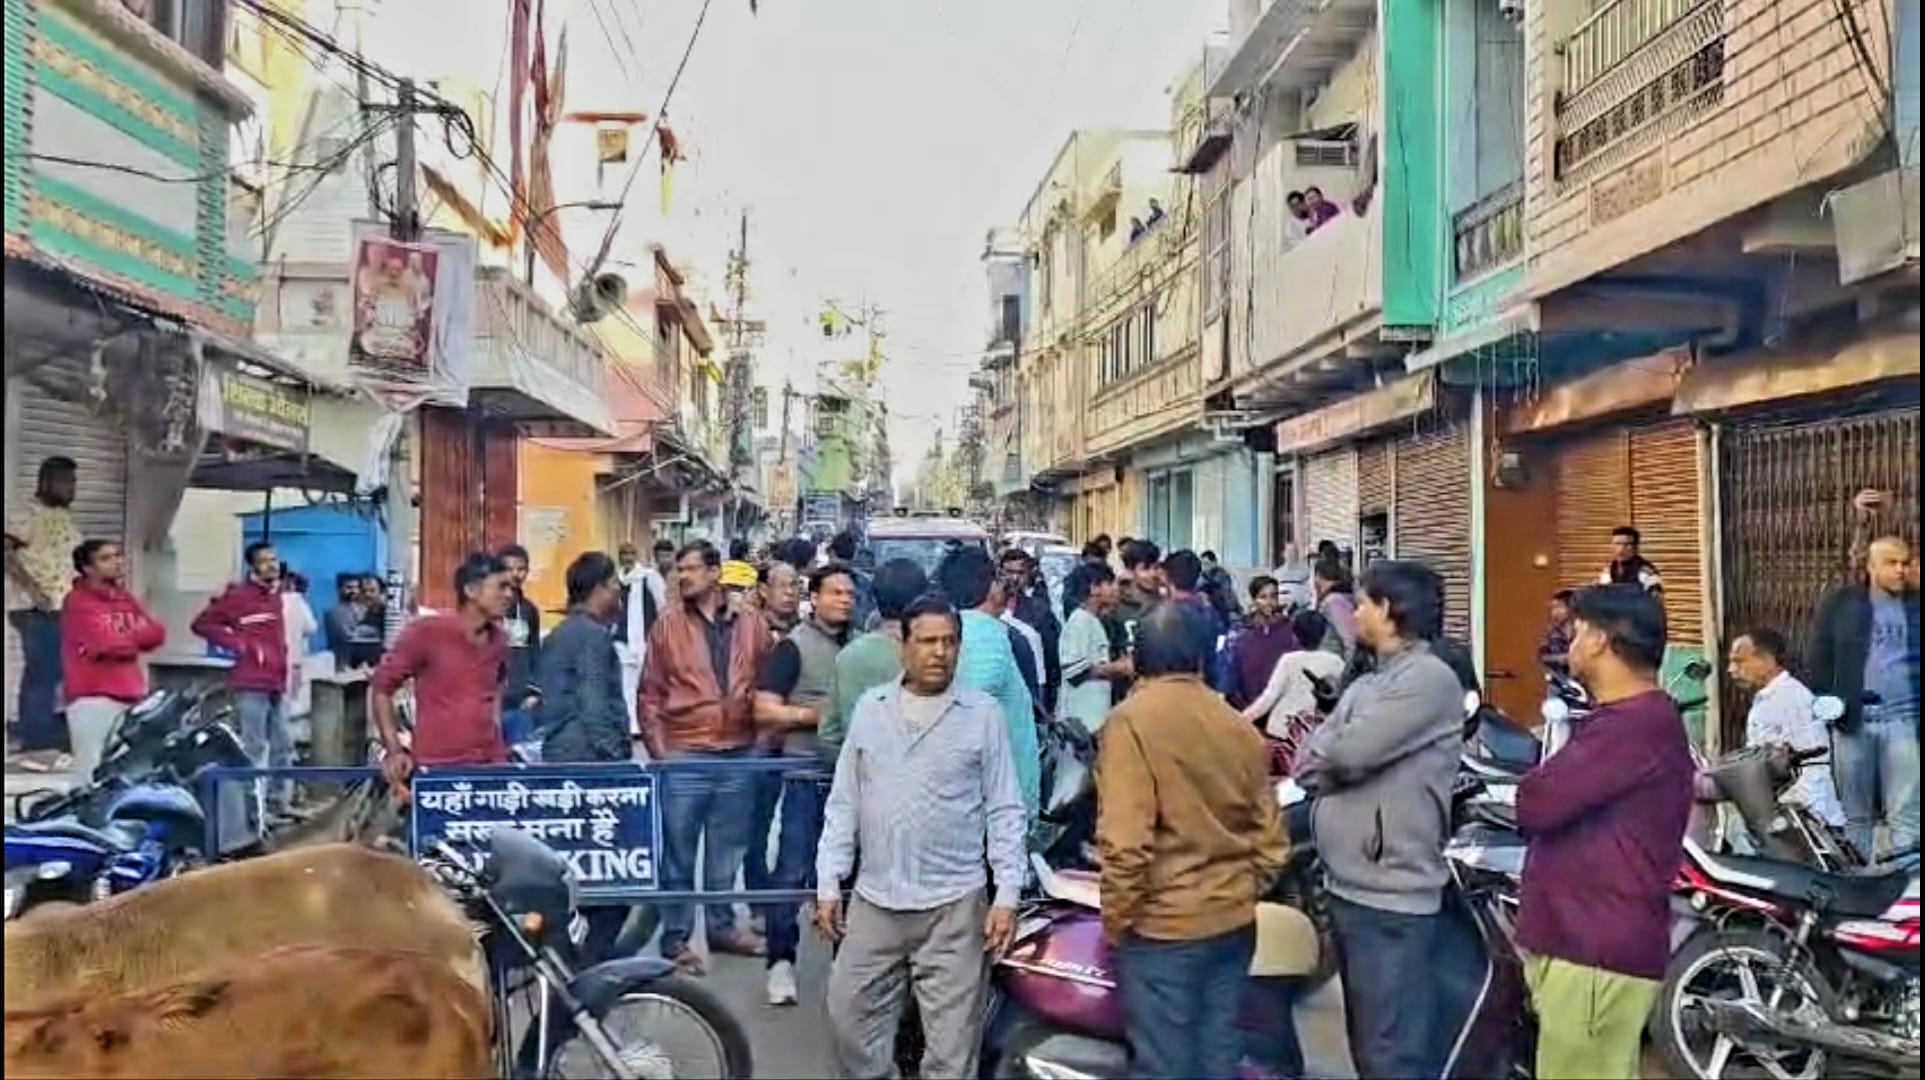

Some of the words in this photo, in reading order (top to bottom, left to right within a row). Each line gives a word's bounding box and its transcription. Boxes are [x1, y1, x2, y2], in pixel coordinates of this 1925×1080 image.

[419, 782, 472, 815] यहाँ
[474, 781, 531, 815] गाड़ी
[531, 780, 584, 815] खड़ी
[586, 787, 649, 808] करना
